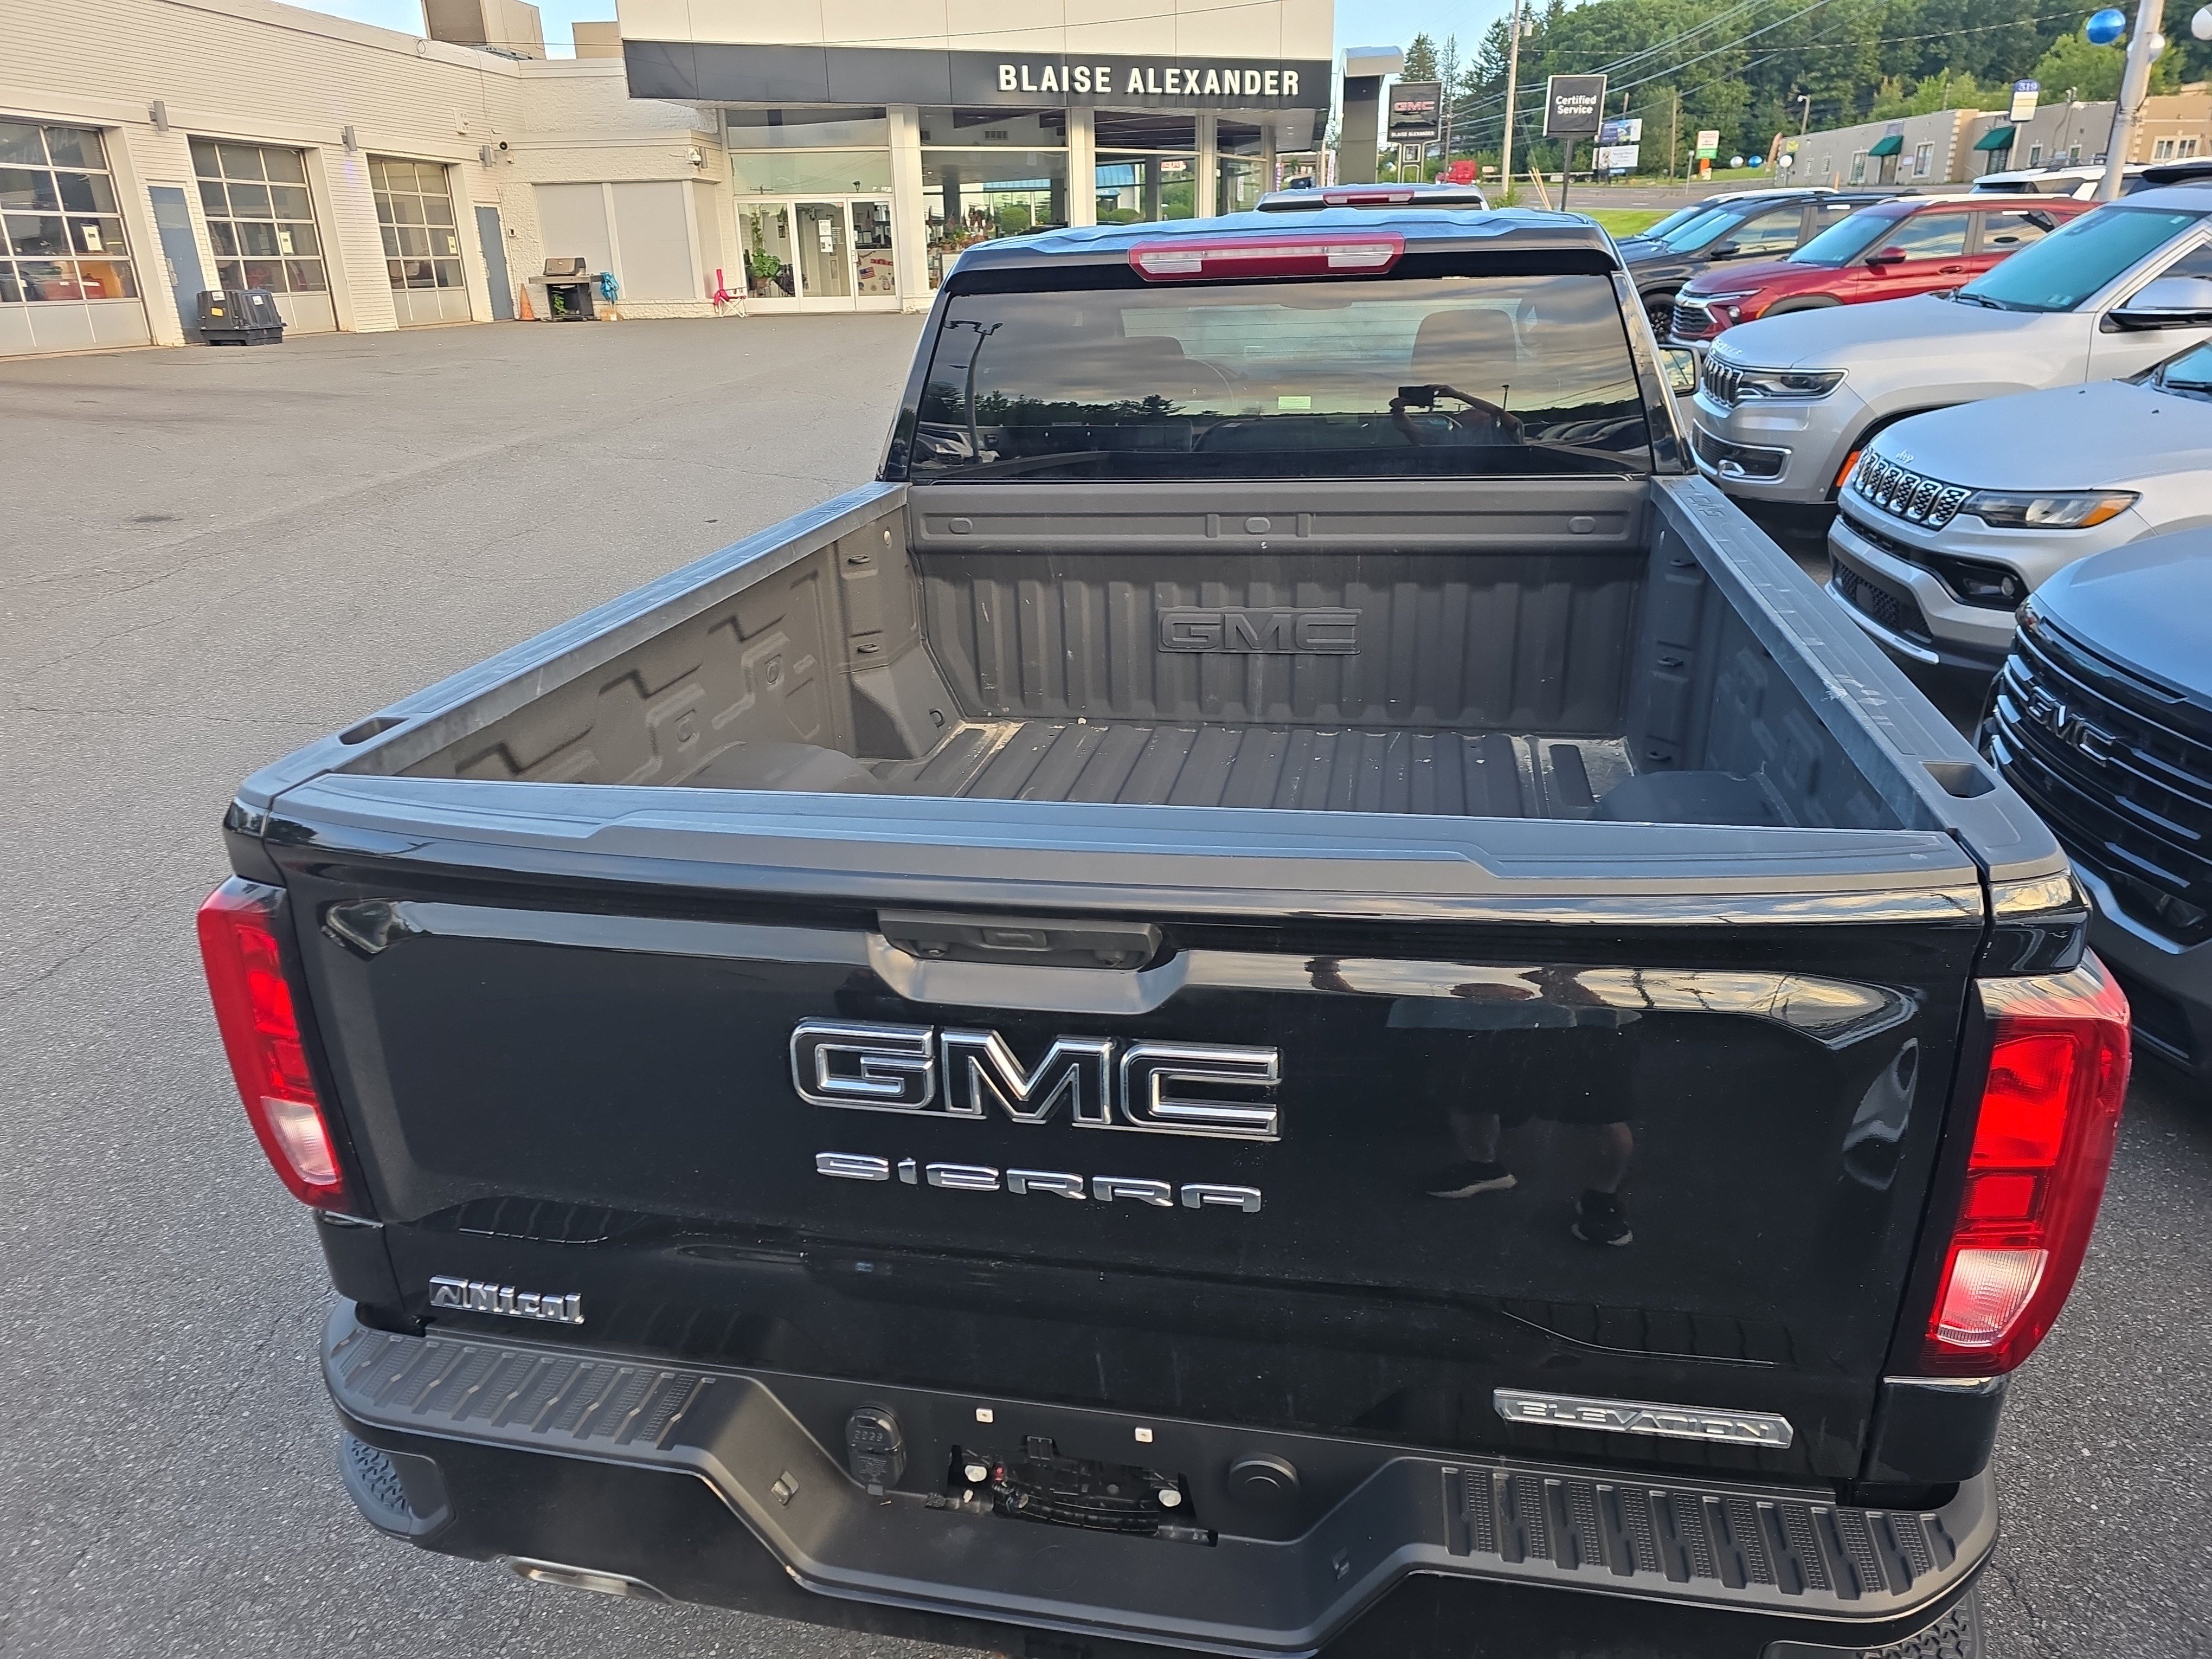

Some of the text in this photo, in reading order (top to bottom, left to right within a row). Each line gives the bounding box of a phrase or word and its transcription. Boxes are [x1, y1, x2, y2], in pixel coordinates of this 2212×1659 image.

[997, 64, 1300, 96] BLAISE ALEXANDER
[1394, 101, 1435, 111] GMC
[1555, 94, 1597, 105] Certified
[1557, 105, 1593, 114] Service
[1161, 613, 1358, 650] GMC
[2027, 685, 2117, 768] GMC
[790, 1017, 1282, 1142] GMC
[815, 1150, 1262, 1213] SIERRA
[1516, 1399, 1771, 1438] ELEVATION
